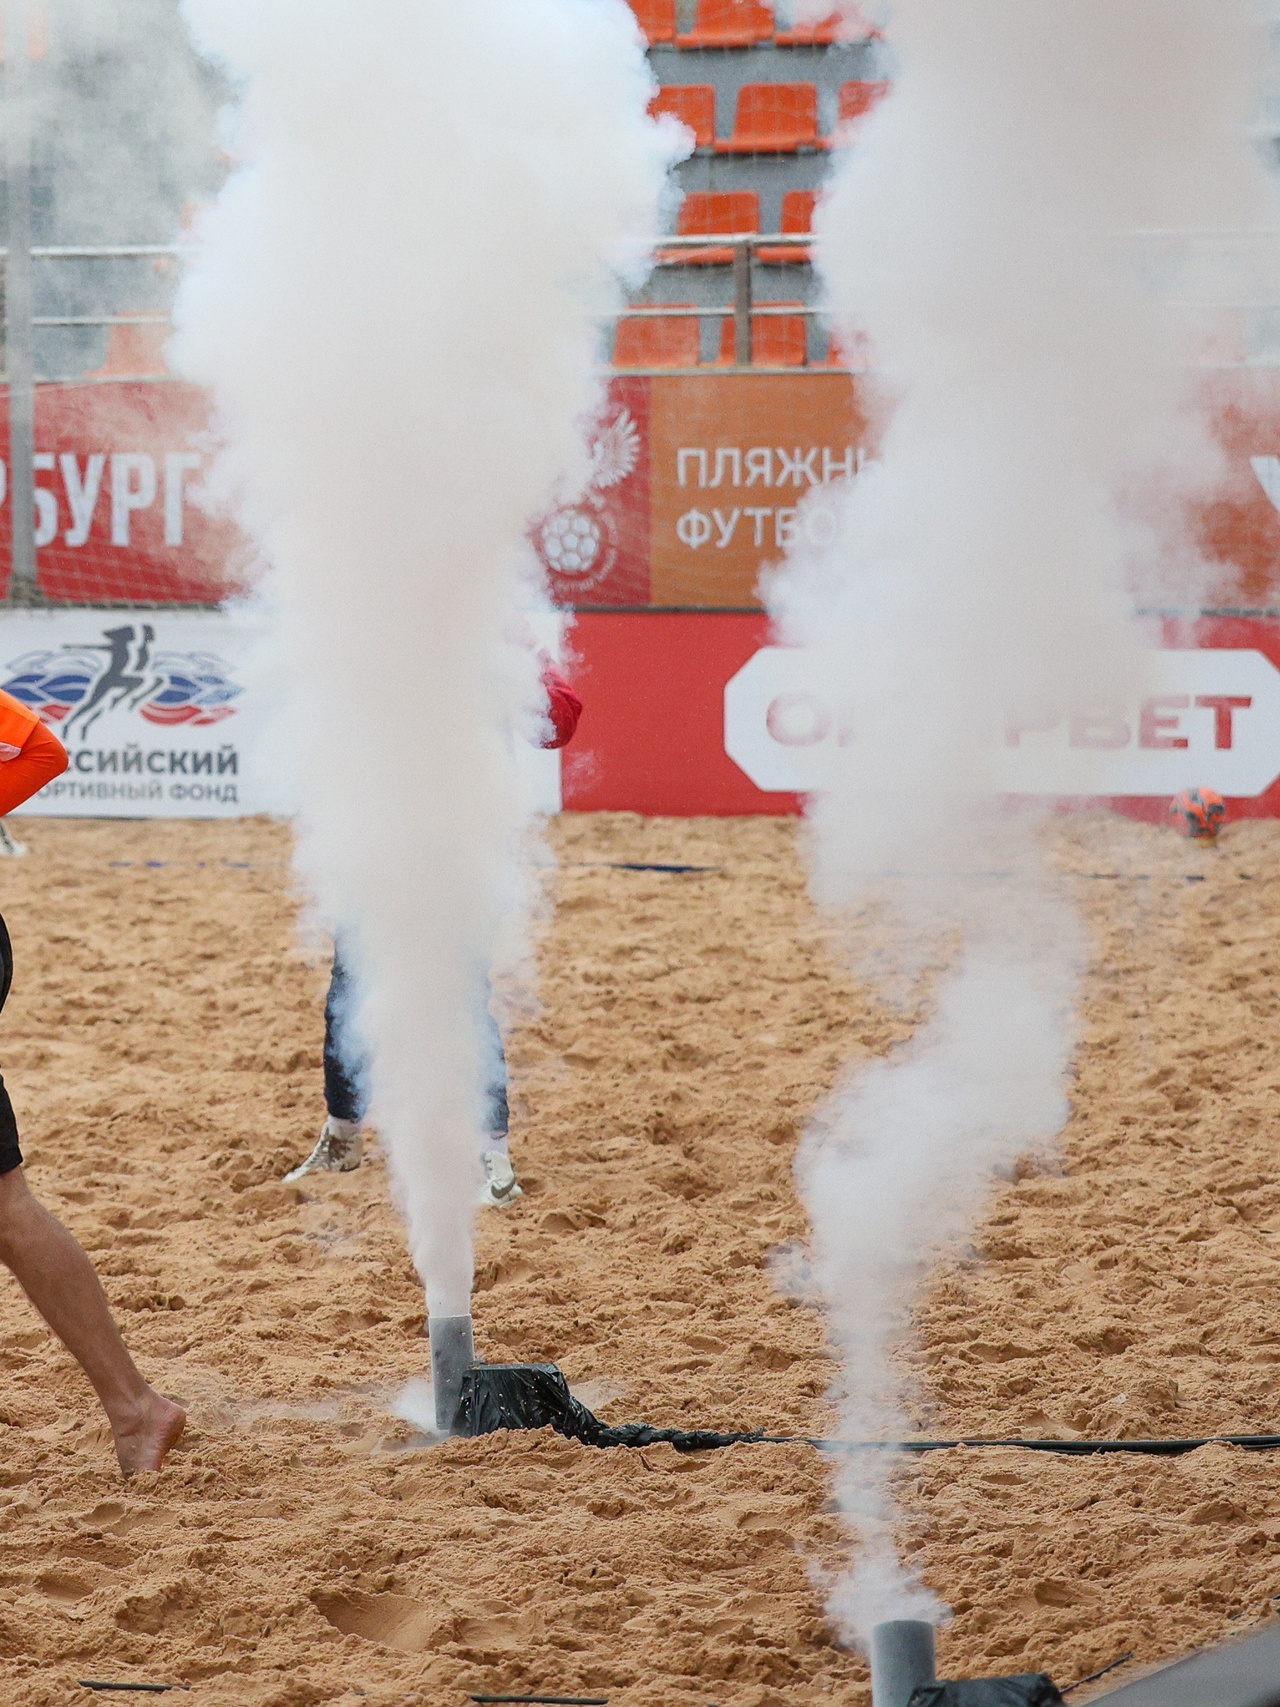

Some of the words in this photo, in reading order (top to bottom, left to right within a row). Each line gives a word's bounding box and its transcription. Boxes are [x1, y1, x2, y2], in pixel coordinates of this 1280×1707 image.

[676, 447, 880, 488] ПЛЯЖН
[676, 508, 837, 549] ФУТБО
[766, 694, 1253, 749] OPBET
[68, 743, 239, 776] СИЙСКИЙ
[38, 779, 163, 801] ОРТИВНЫЙ
[169, 783, 239, 804] ФОНД
